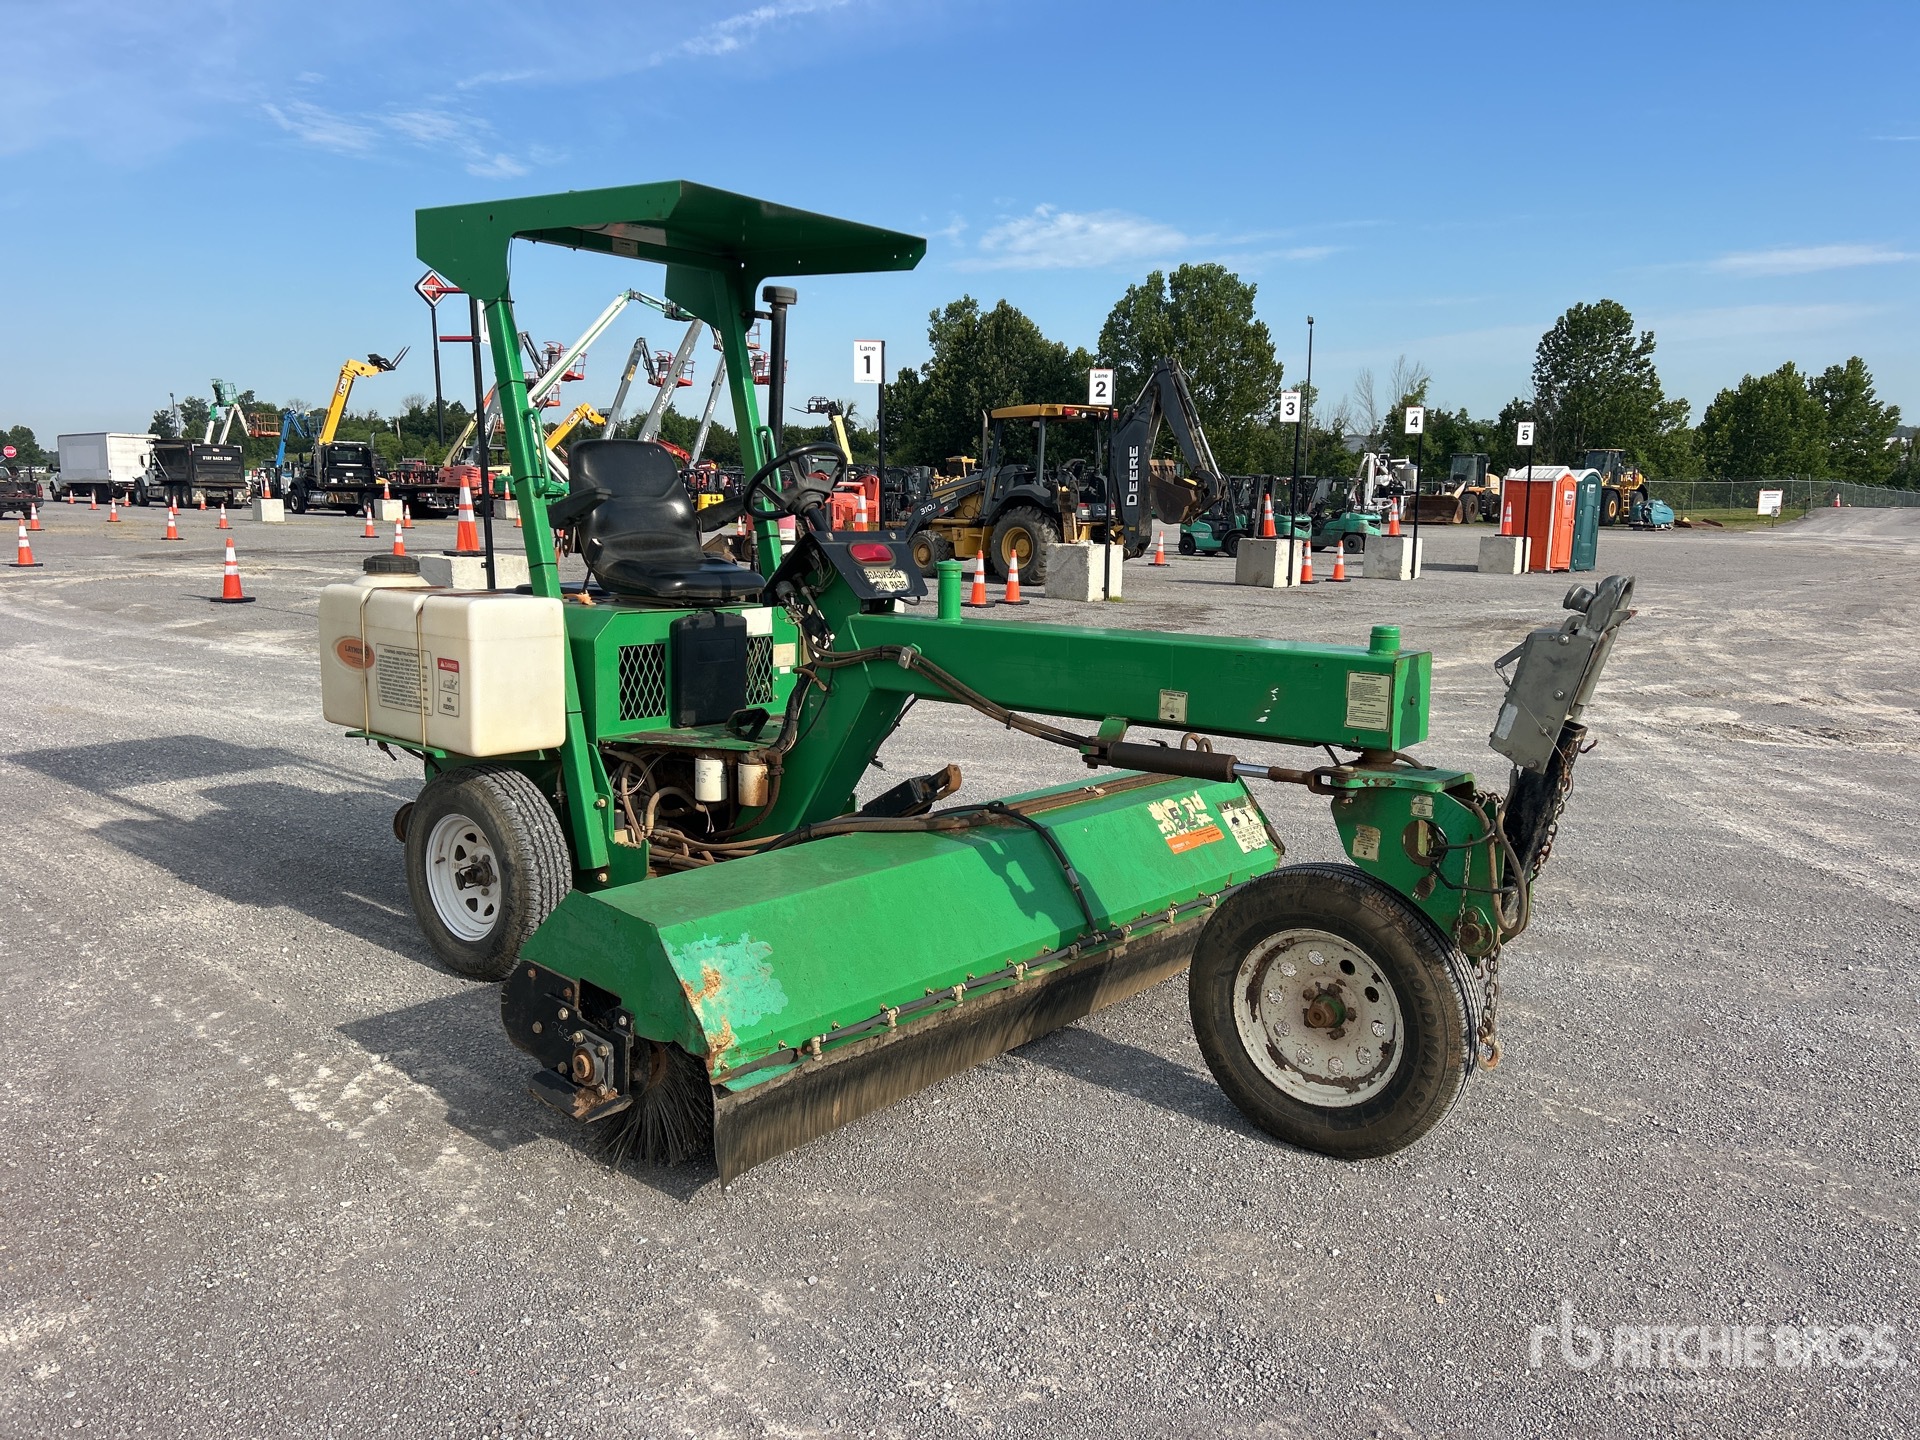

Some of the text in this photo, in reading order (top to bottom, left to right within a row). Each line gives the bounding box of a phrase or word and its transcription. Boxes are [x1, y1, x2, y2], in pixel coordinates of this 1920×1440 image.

[859, 344, 876, 352] Lane
[863, 354, 871, 374] 1
[337, 378, 348, 397] JCB
[1095, 380, 1107, 397] 2
[1285, 401, 1296, 416] 3
[1409, 415, 1419, 428] 4
[1521, 429, 1530, 441] 5
[1125, 445, 1139, 507] DEERE
[920, 503, 937, 516] 310J
